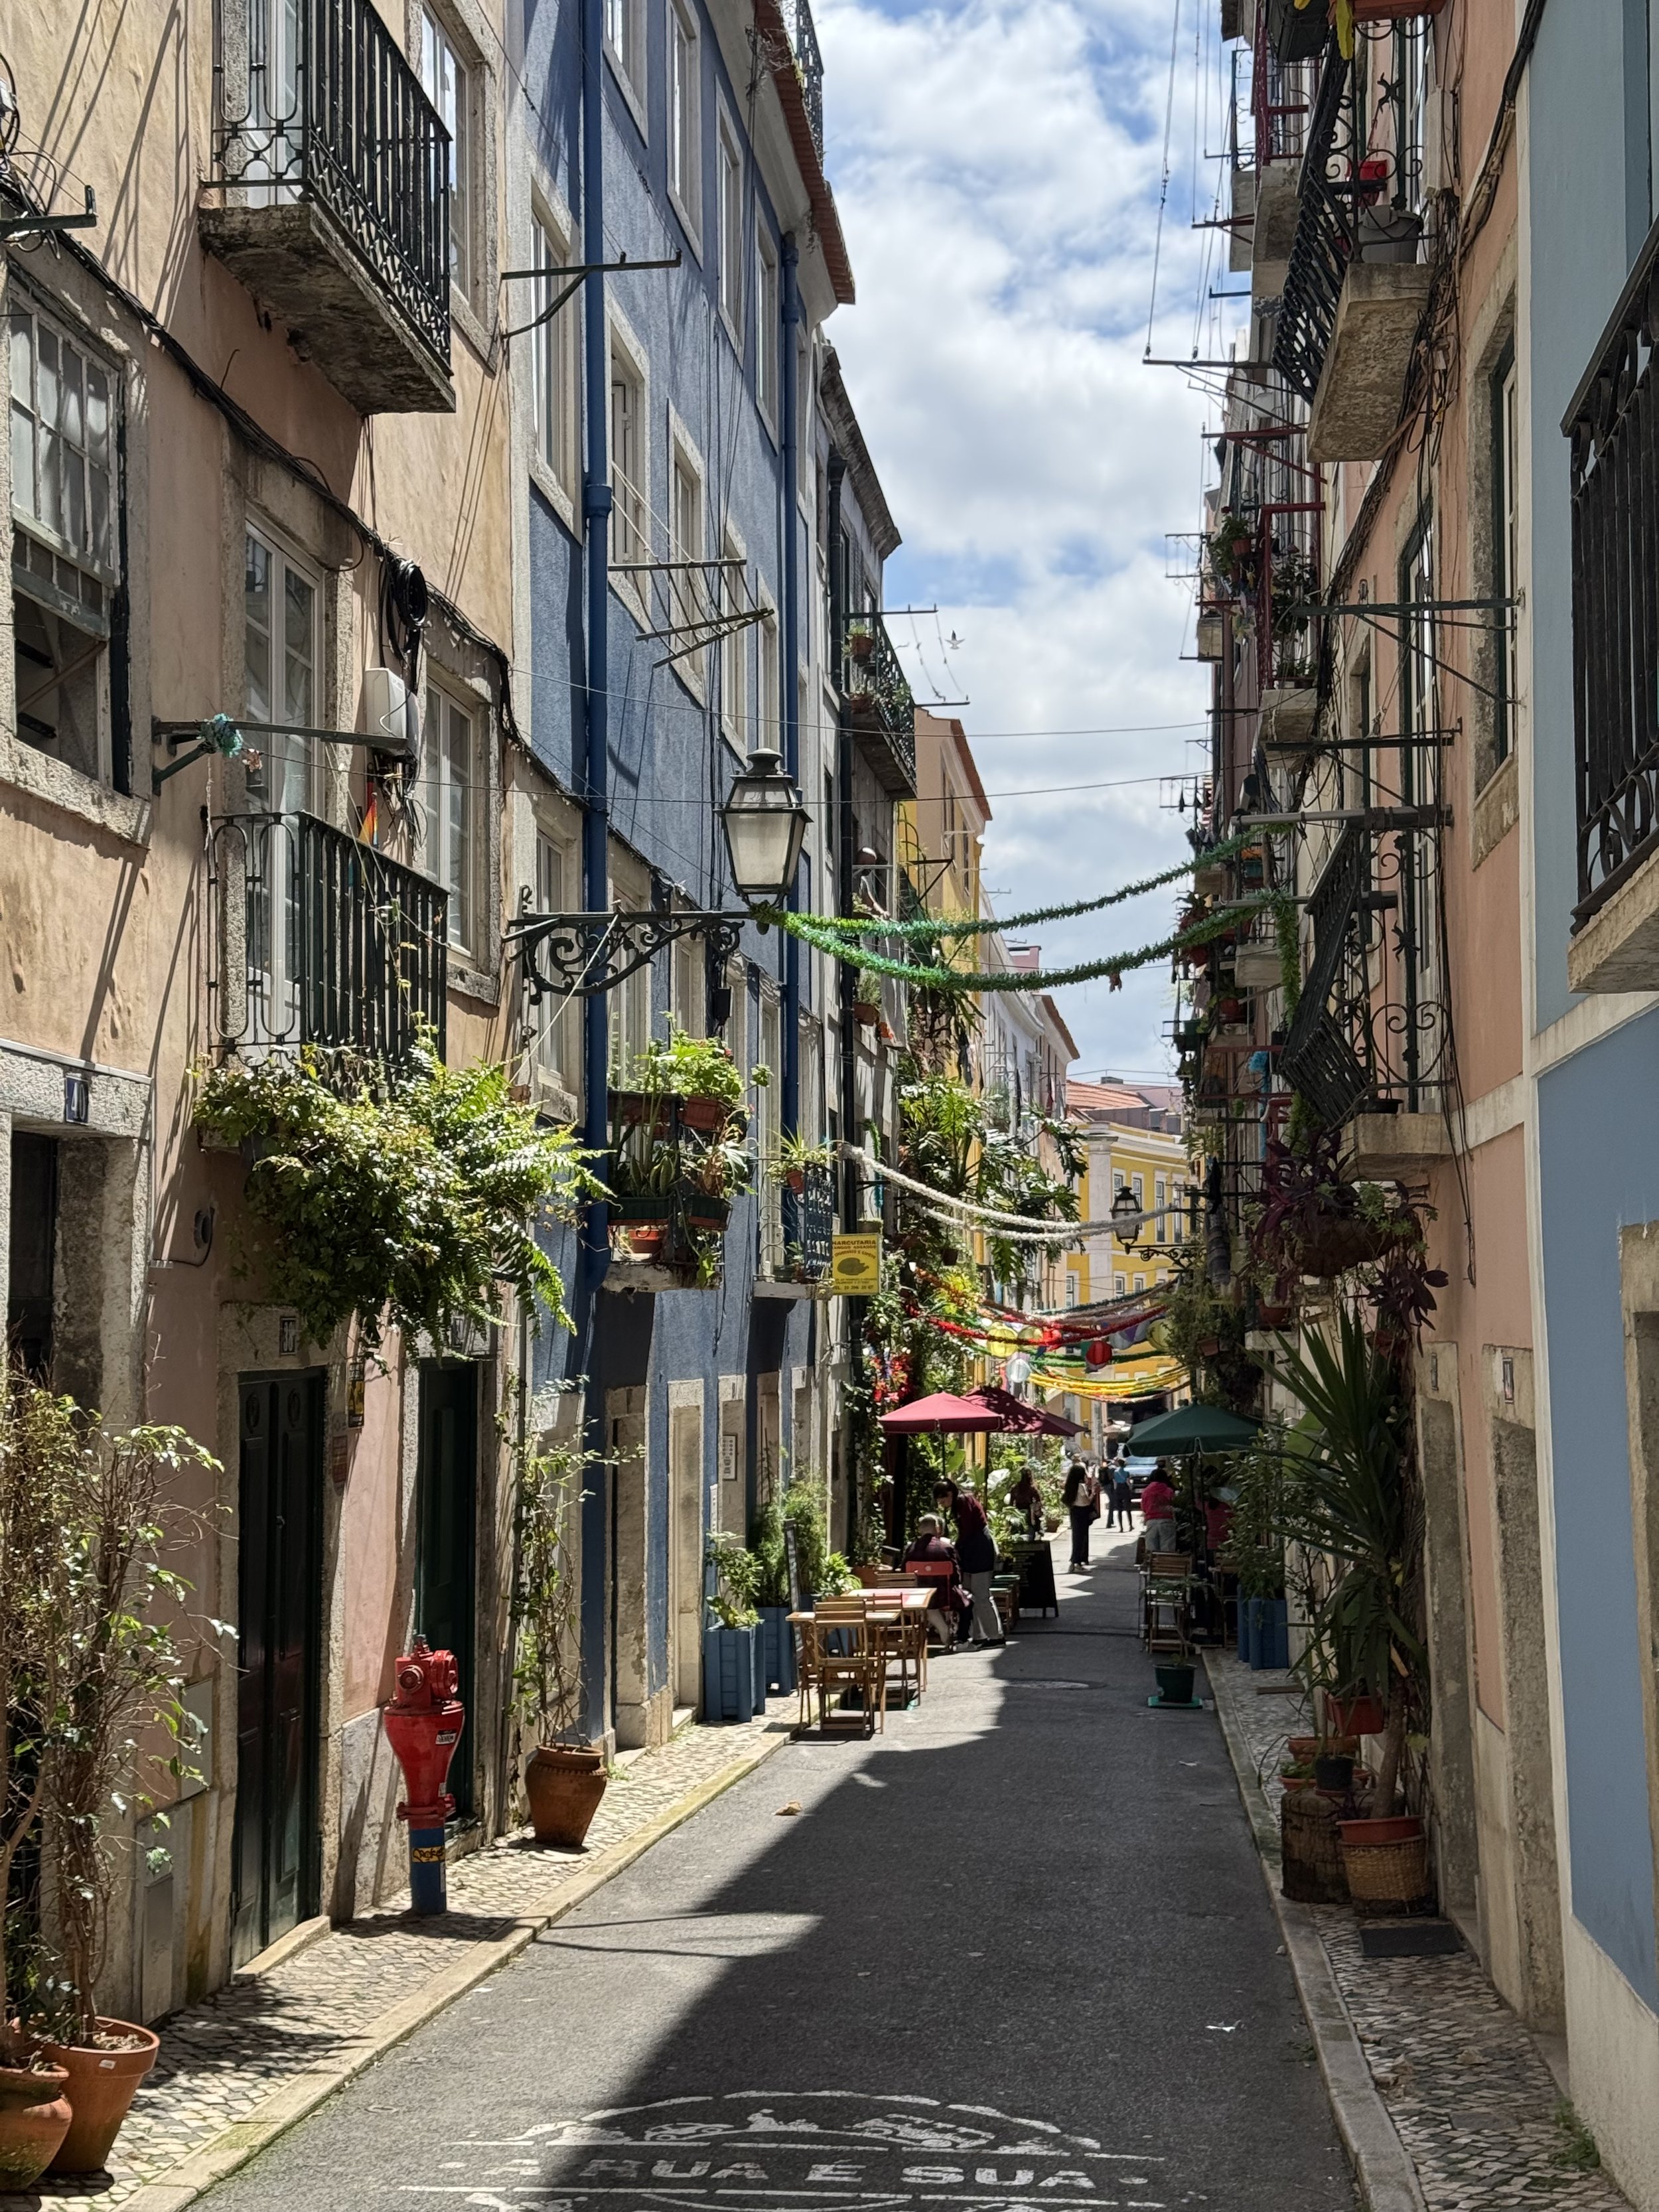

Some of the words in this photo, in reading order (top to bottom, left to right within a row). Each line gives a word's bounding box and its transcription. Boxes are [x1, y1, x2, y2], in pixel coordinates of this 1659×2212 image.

[71, 1082, 85, 1120] 40
[479, 2159, 542, 2176] A
[576, 2158, 770, 2178] RUA
[900, 2165, 1098, 2187] SUA
